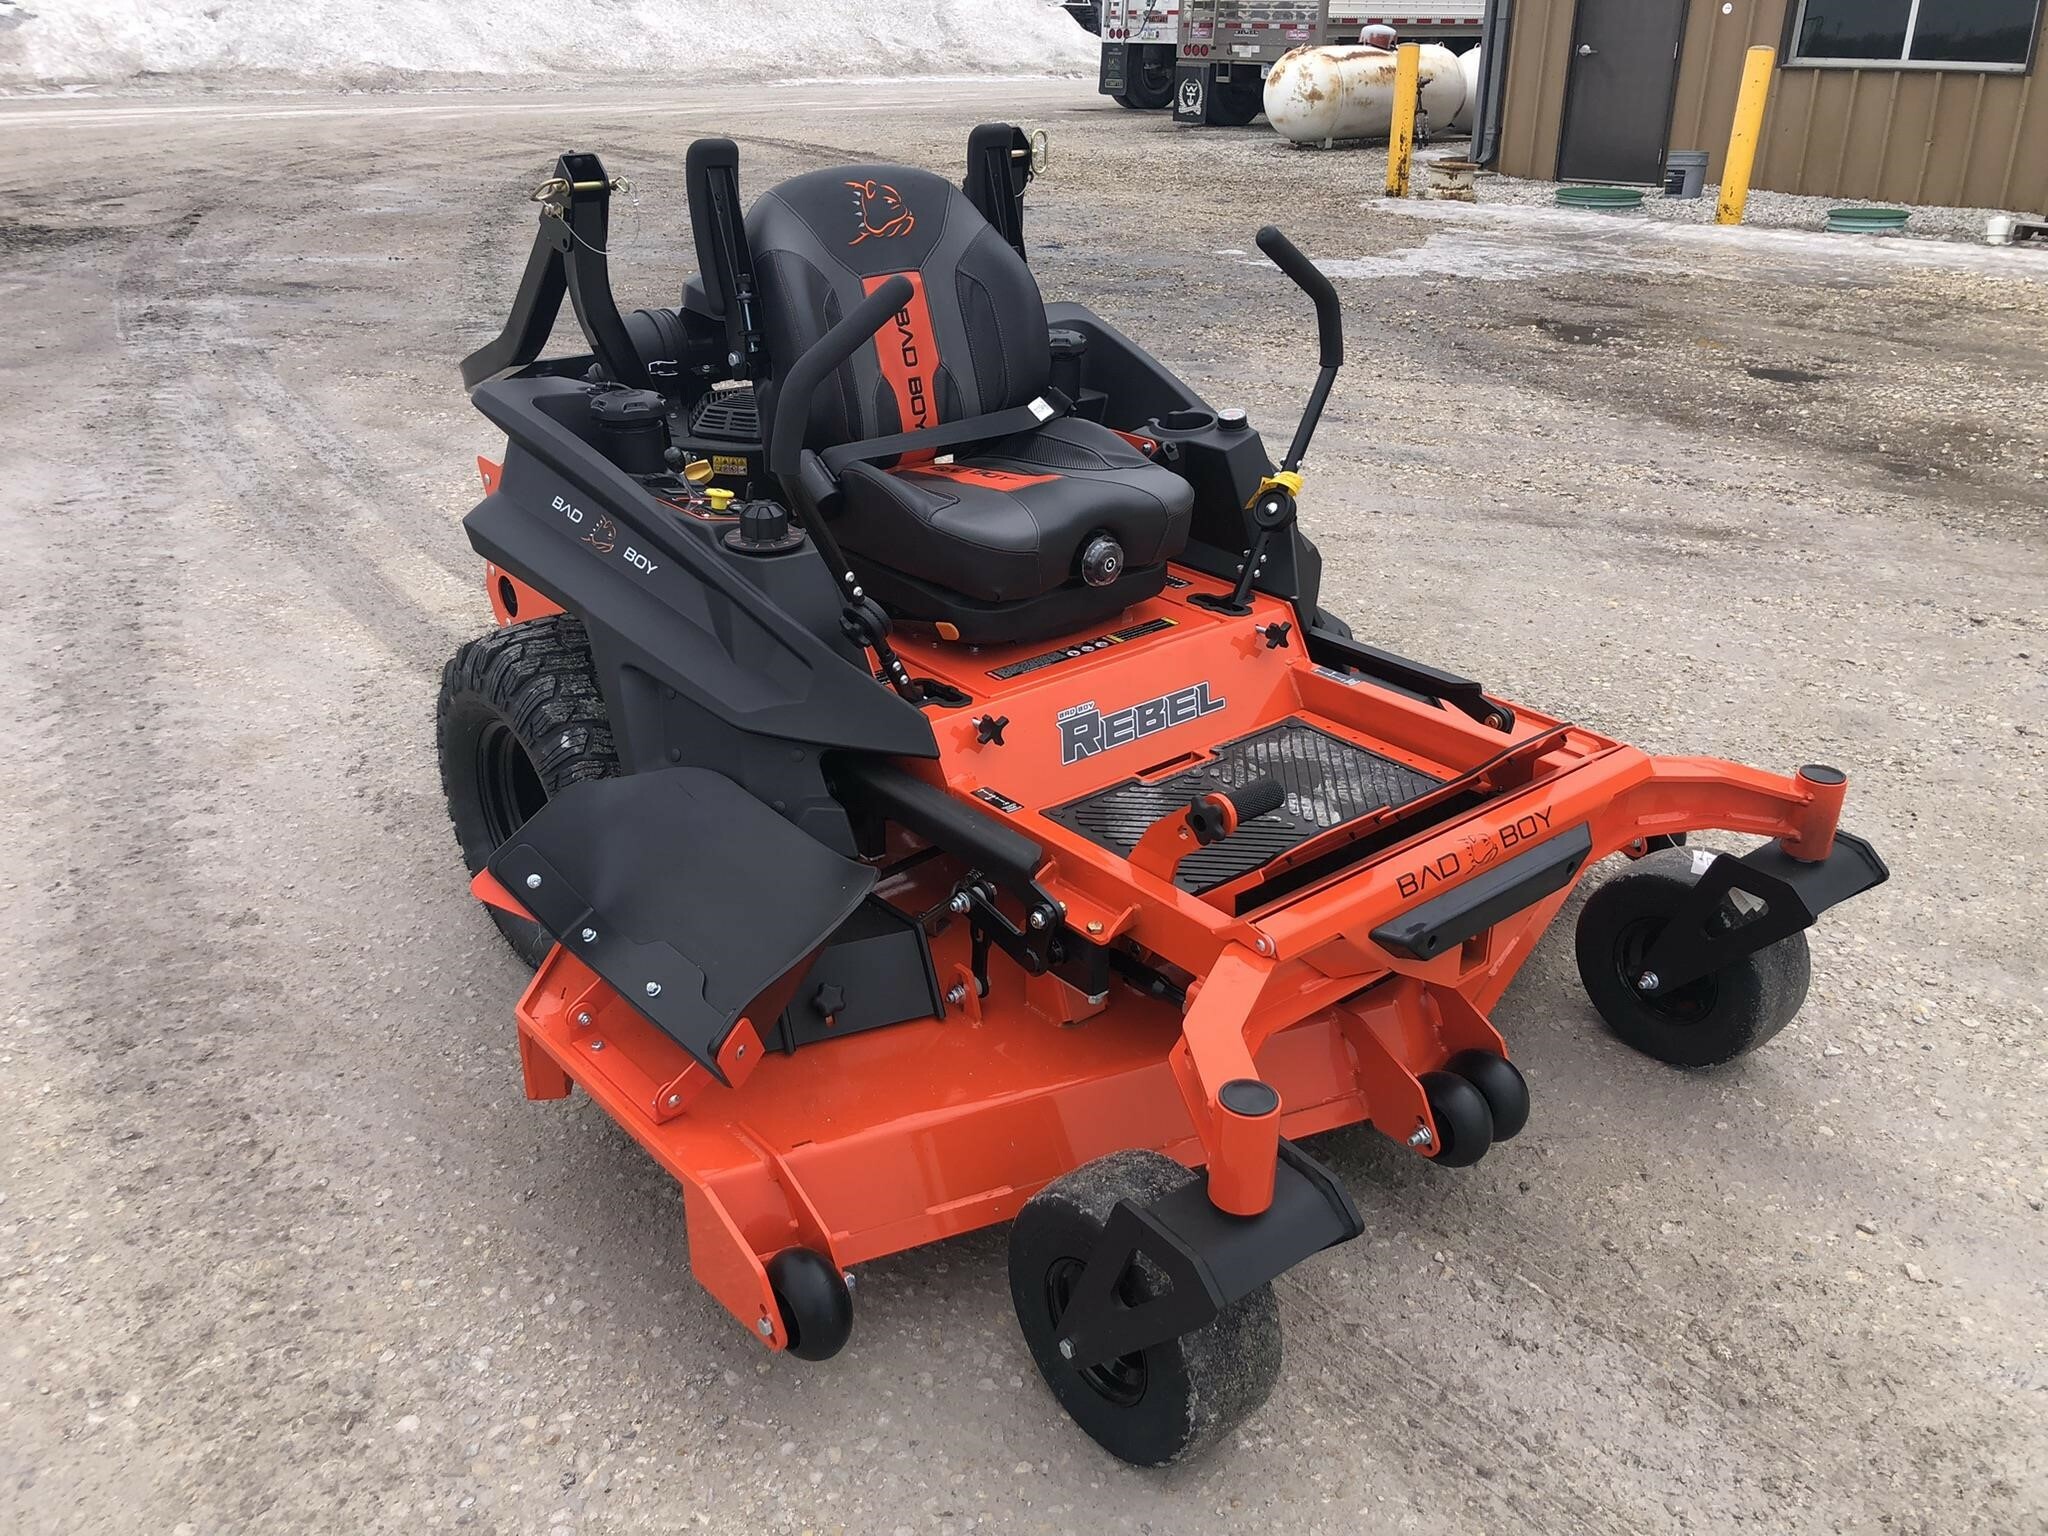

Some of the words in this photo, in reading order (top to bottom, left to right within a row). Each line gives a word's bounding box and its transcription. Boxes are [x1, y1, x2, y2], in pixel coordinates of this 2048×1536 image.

[895, 307, 918, 368] BAD
[907, 376, 929, 430] BOY
[551, 495, 584, 524] BAD
[623, 546, 658, 575] BOY
[1056, 681, 1226, 766] REBEL
[1057, 707, 1076, 720] BAD
[1076, 701, 1096, 714] BOY
[1396, 852, 1460, 899] BAD
[1499, 805, 1552, 849] BOY
